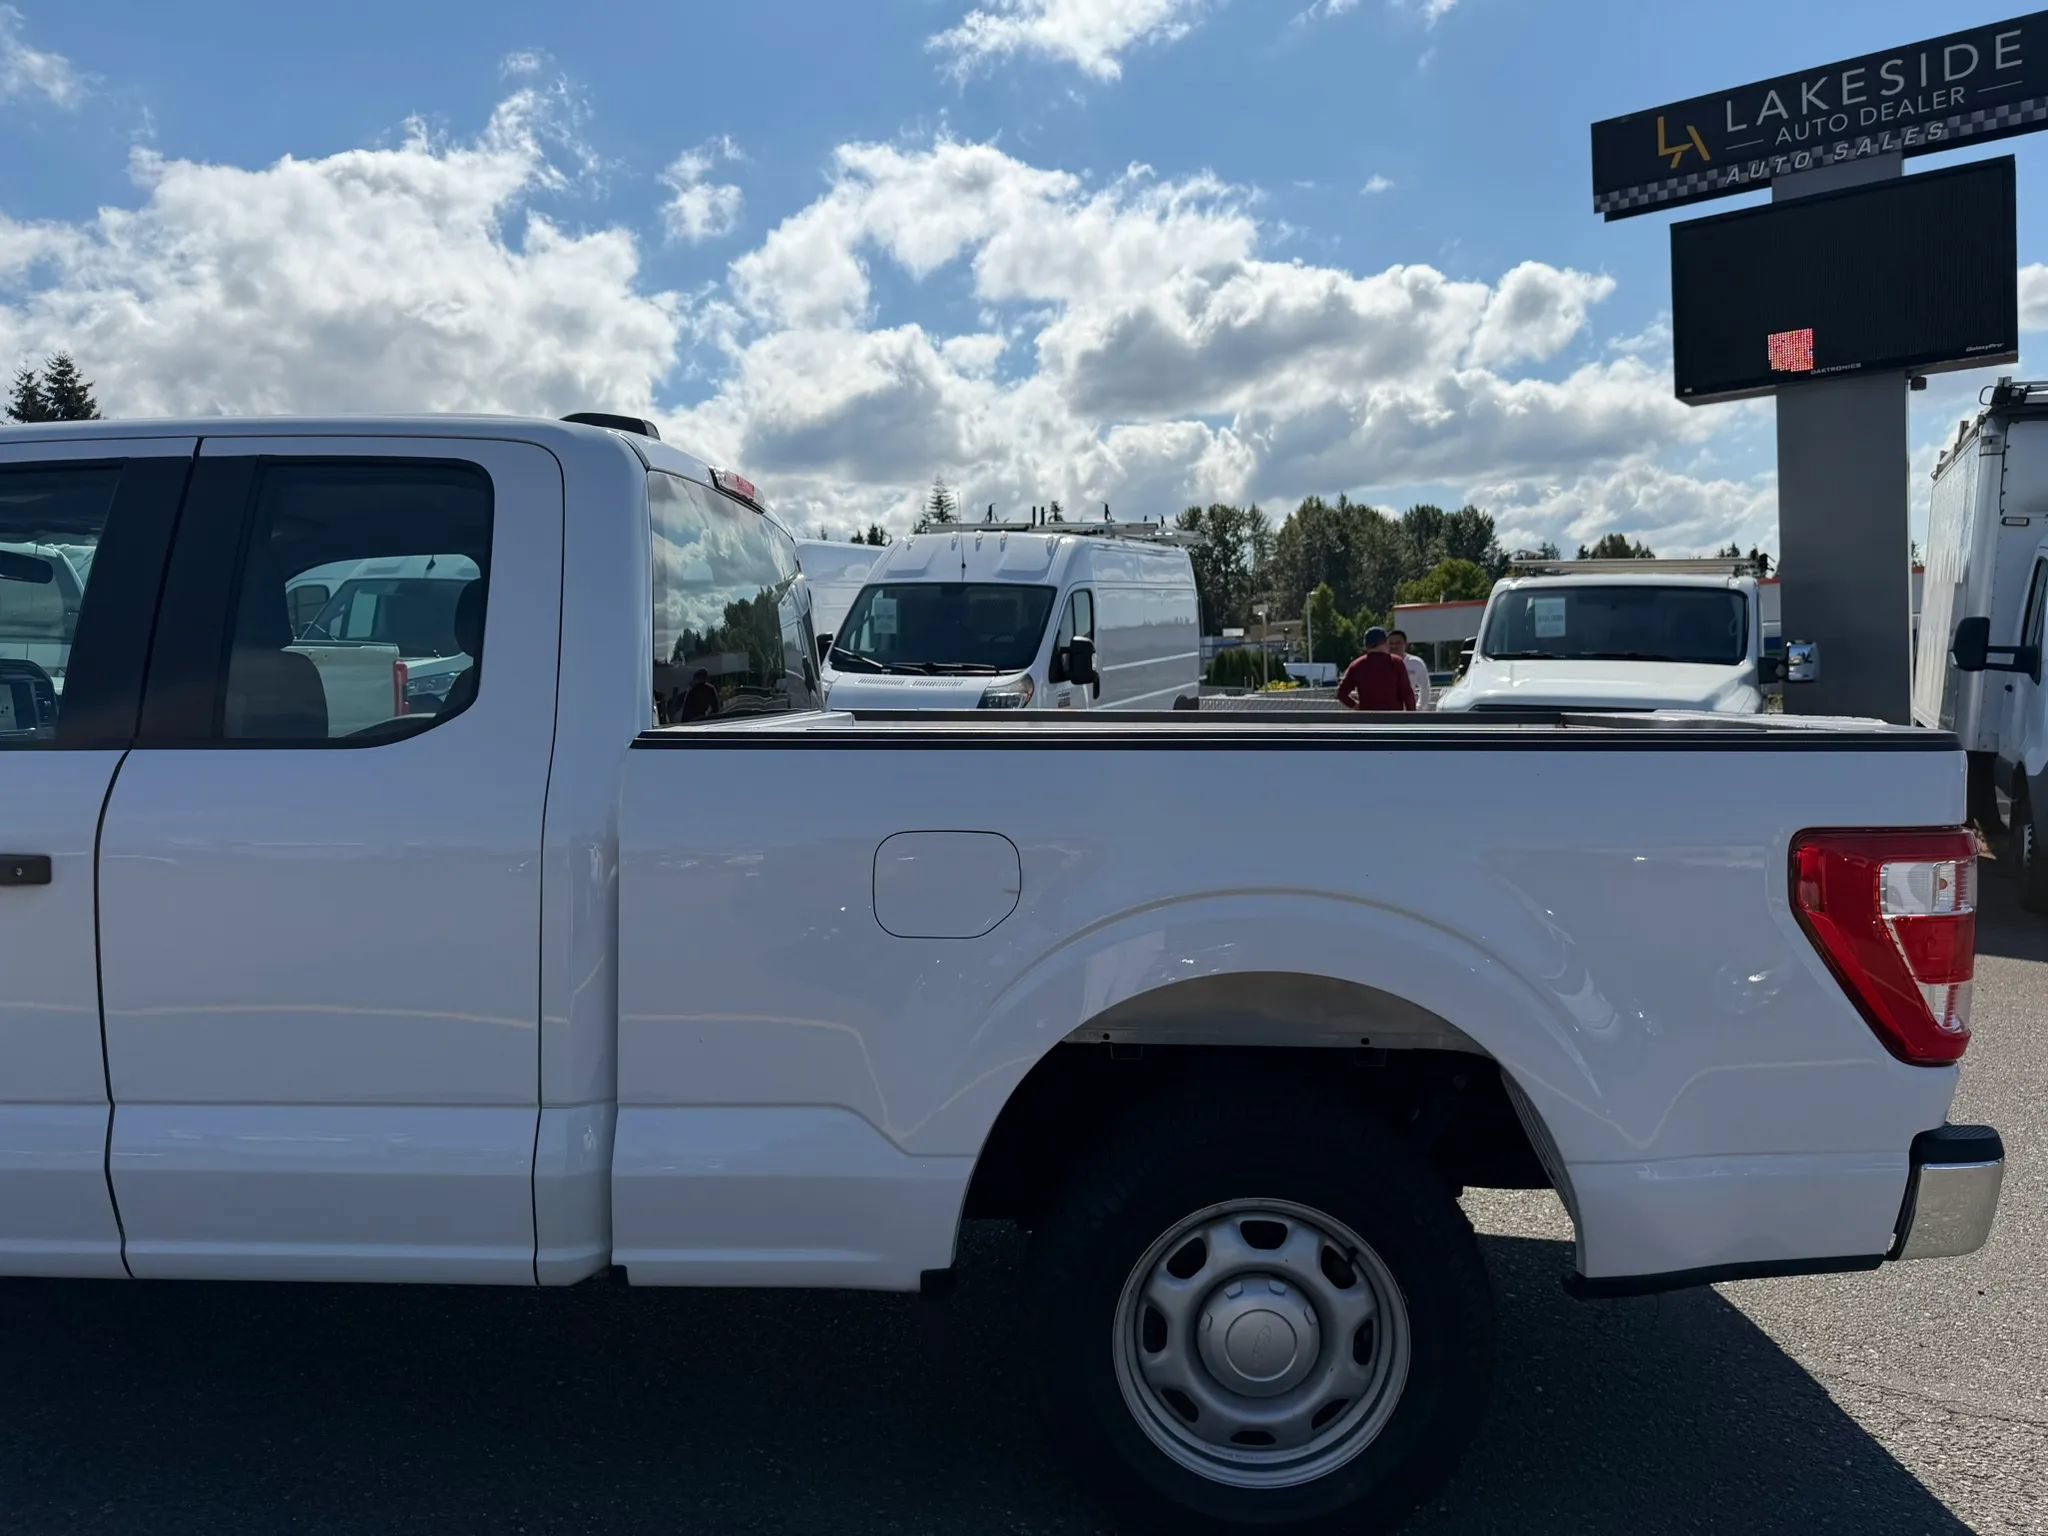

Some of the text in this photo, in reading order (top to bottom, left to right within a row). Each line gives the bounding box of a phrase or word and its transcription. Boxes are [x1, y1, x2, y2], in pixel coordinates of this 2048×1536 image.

[1725, 29, 2024, 133] LAKESIDE
[1775, 86, 1965, 145] AUTO DEALER
[1726, 121, 1944, 184] AUTO SALES
